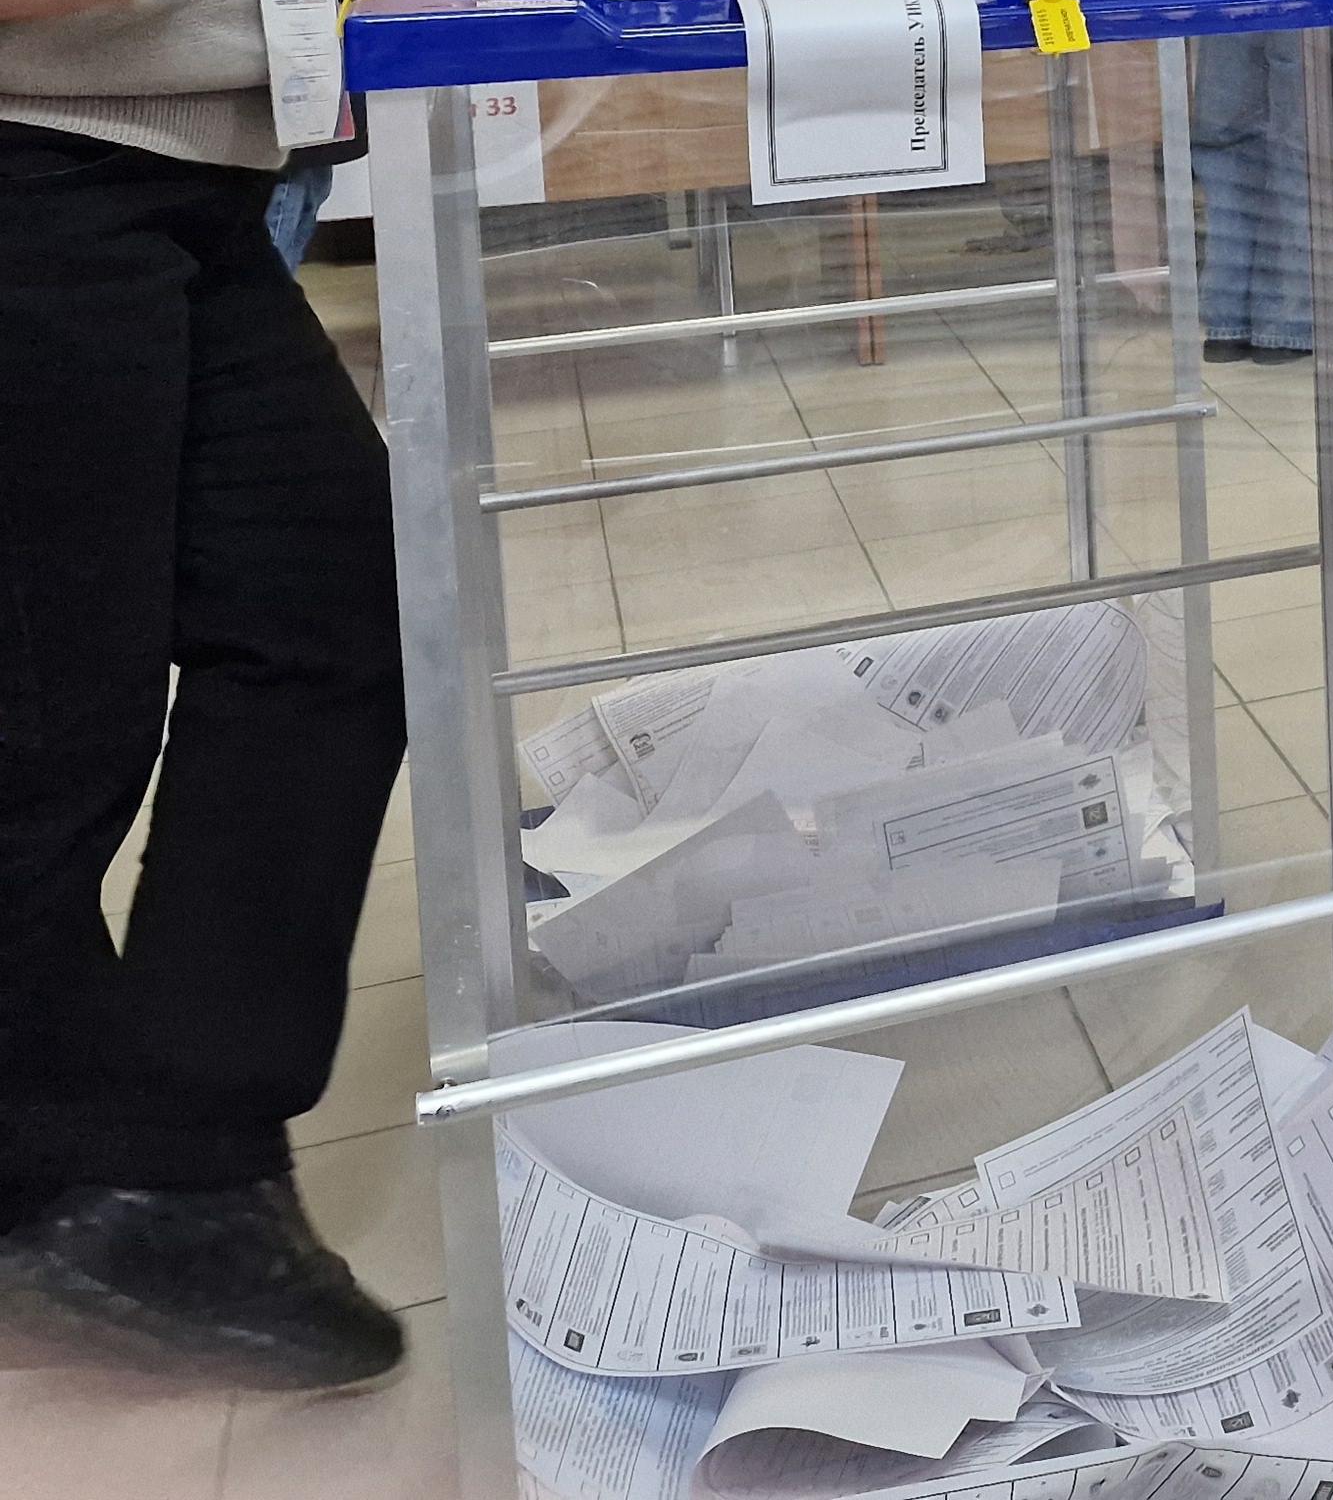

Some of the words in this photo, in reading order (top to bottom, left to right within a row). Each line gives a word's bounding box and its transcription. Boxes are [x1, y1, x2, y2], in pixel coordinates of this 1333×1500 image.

[904, 0, 924, 32] УИК
[486, 96, 518, 116] 33
[909, 36, 929, 152] Председатель
